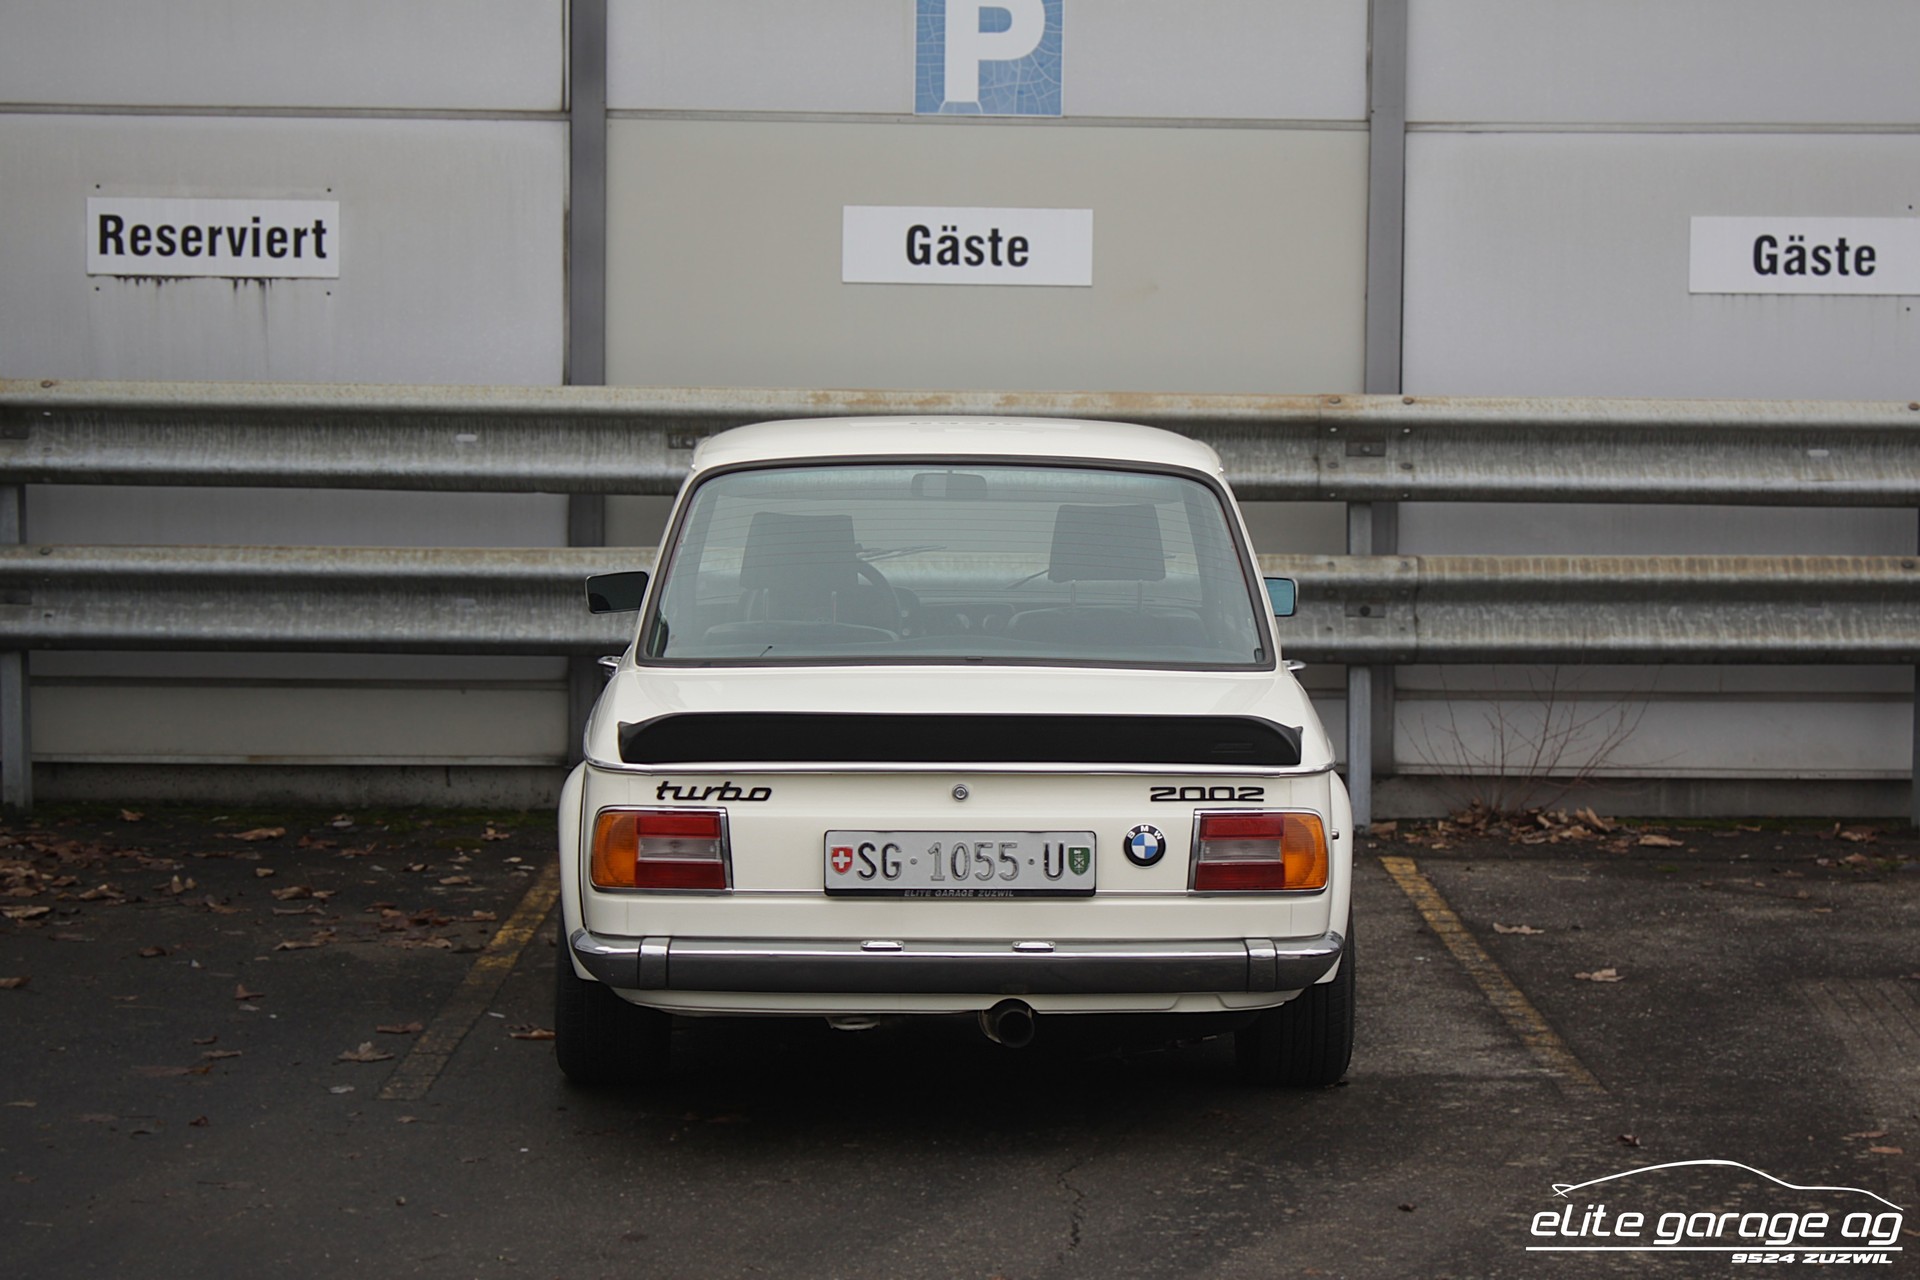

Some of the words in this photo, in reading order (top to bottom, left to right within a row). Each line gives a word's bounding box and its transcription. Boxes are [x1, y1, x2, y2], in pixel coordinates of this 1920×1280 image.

[945, 0, 1045, 102] P
[98, 213, 328, 260] Reserviert
[906, 224, 1030, 268] Gäste
[1752, 234, 1877, 277] Gäste
[656, 780, 773, 802] turbo
[1149, 786, 1265, 803] 2002
[1126, 825, 1163, 840] BMW
[927, 841, 1020, 882] 1055
[903, 889, 931, 898] ELITE
[934, 889, 974, 898] GARAGE
[978, 889, 1014, 898] ZUZWIL
